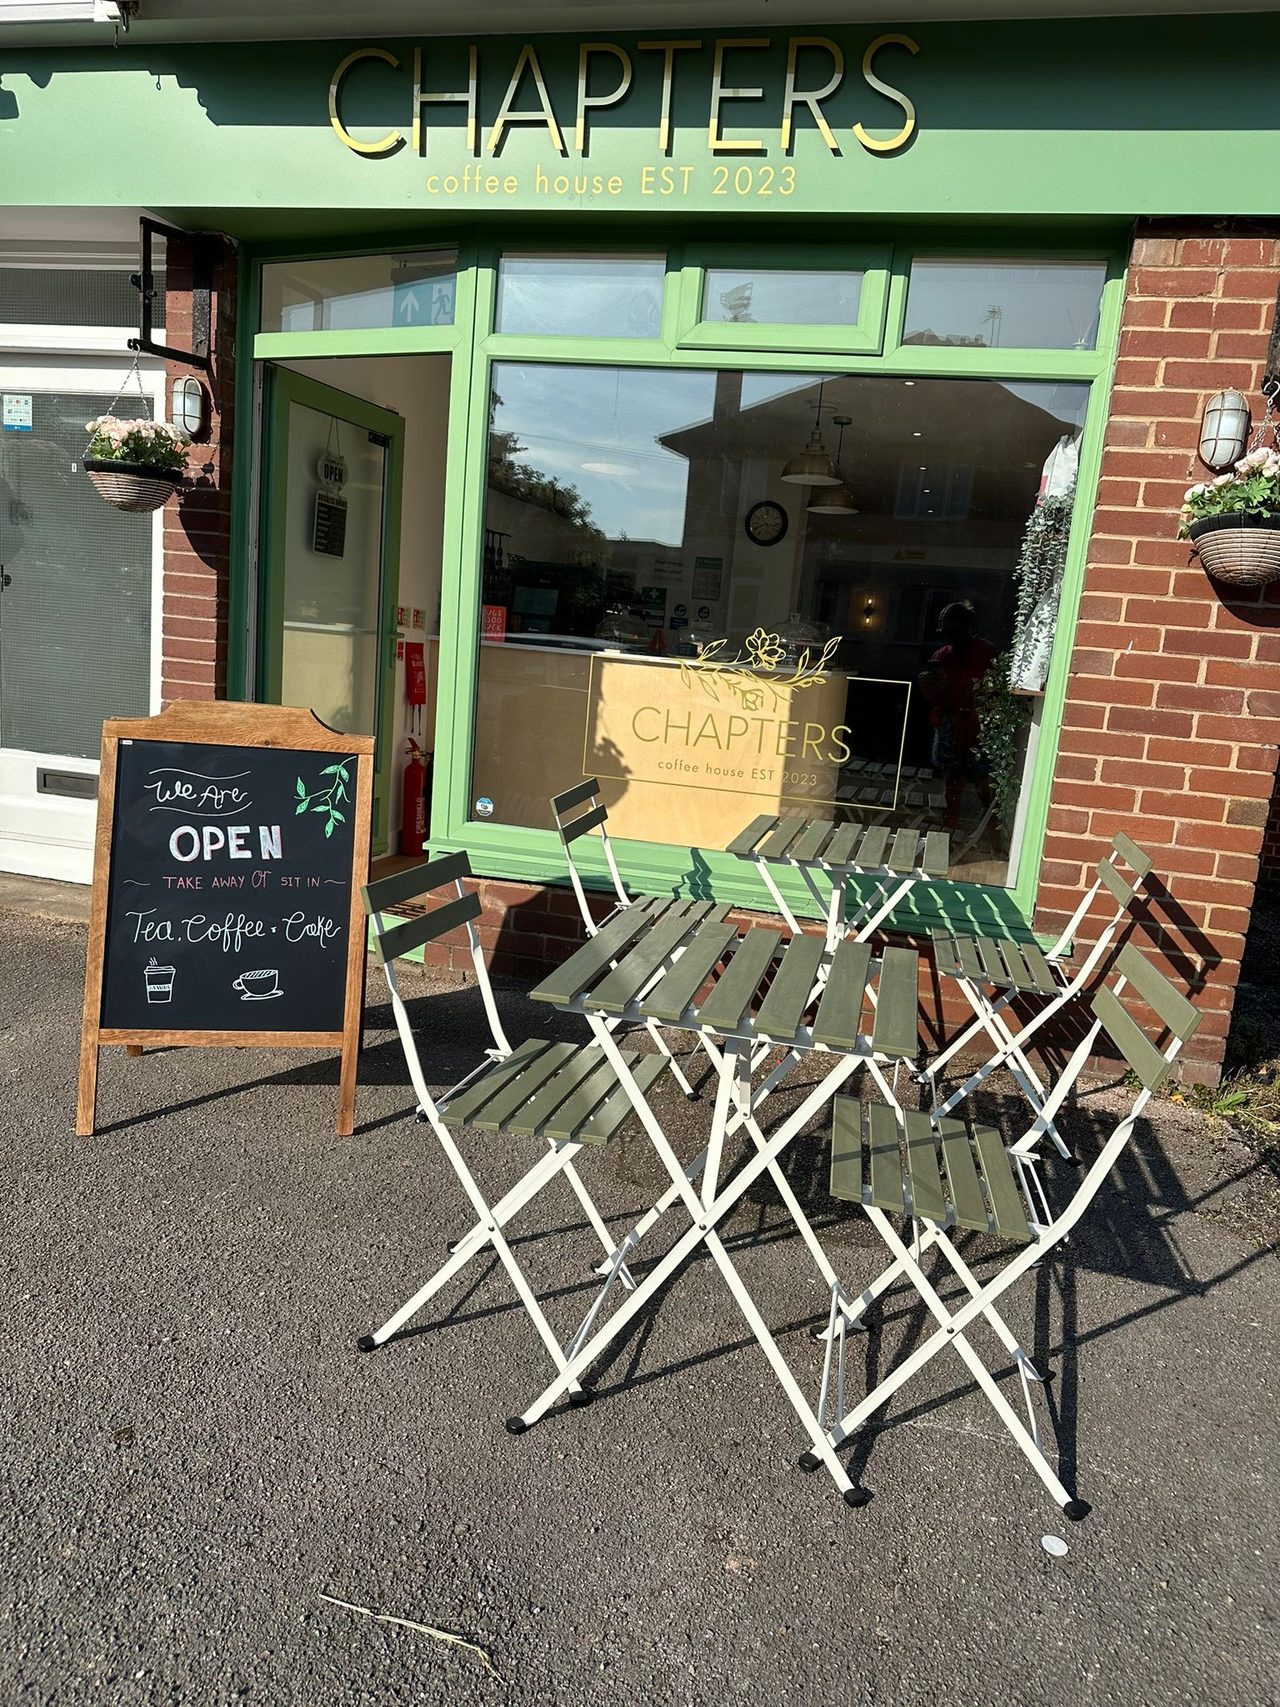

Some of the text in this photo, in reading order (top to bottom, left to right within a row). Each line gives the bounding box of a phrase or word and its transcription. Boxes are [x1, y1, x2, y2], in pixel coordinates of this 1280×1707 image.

[329, 34, 921, 154] CHAPTERS
[426, 165, 798, 196] coffee house EST 2023
[324, 463, 344, 483] OPEN
[632, 706, 852, 763] CHAPTERS
[658, 758, 817, 786] coffee house EST 2023
[144, 780, 248, 809] We Are
[169, 825, 282, 862] OPEN
[162, 875, 203, 890] TAKE
[212, 875, 245, 889] AWAY
[280, 876, 301, 888] SIT
[306, 876, 320, 887] IN
[181, 912, 266, 953] Coffee
[282, 911, 342, 949] Cake
